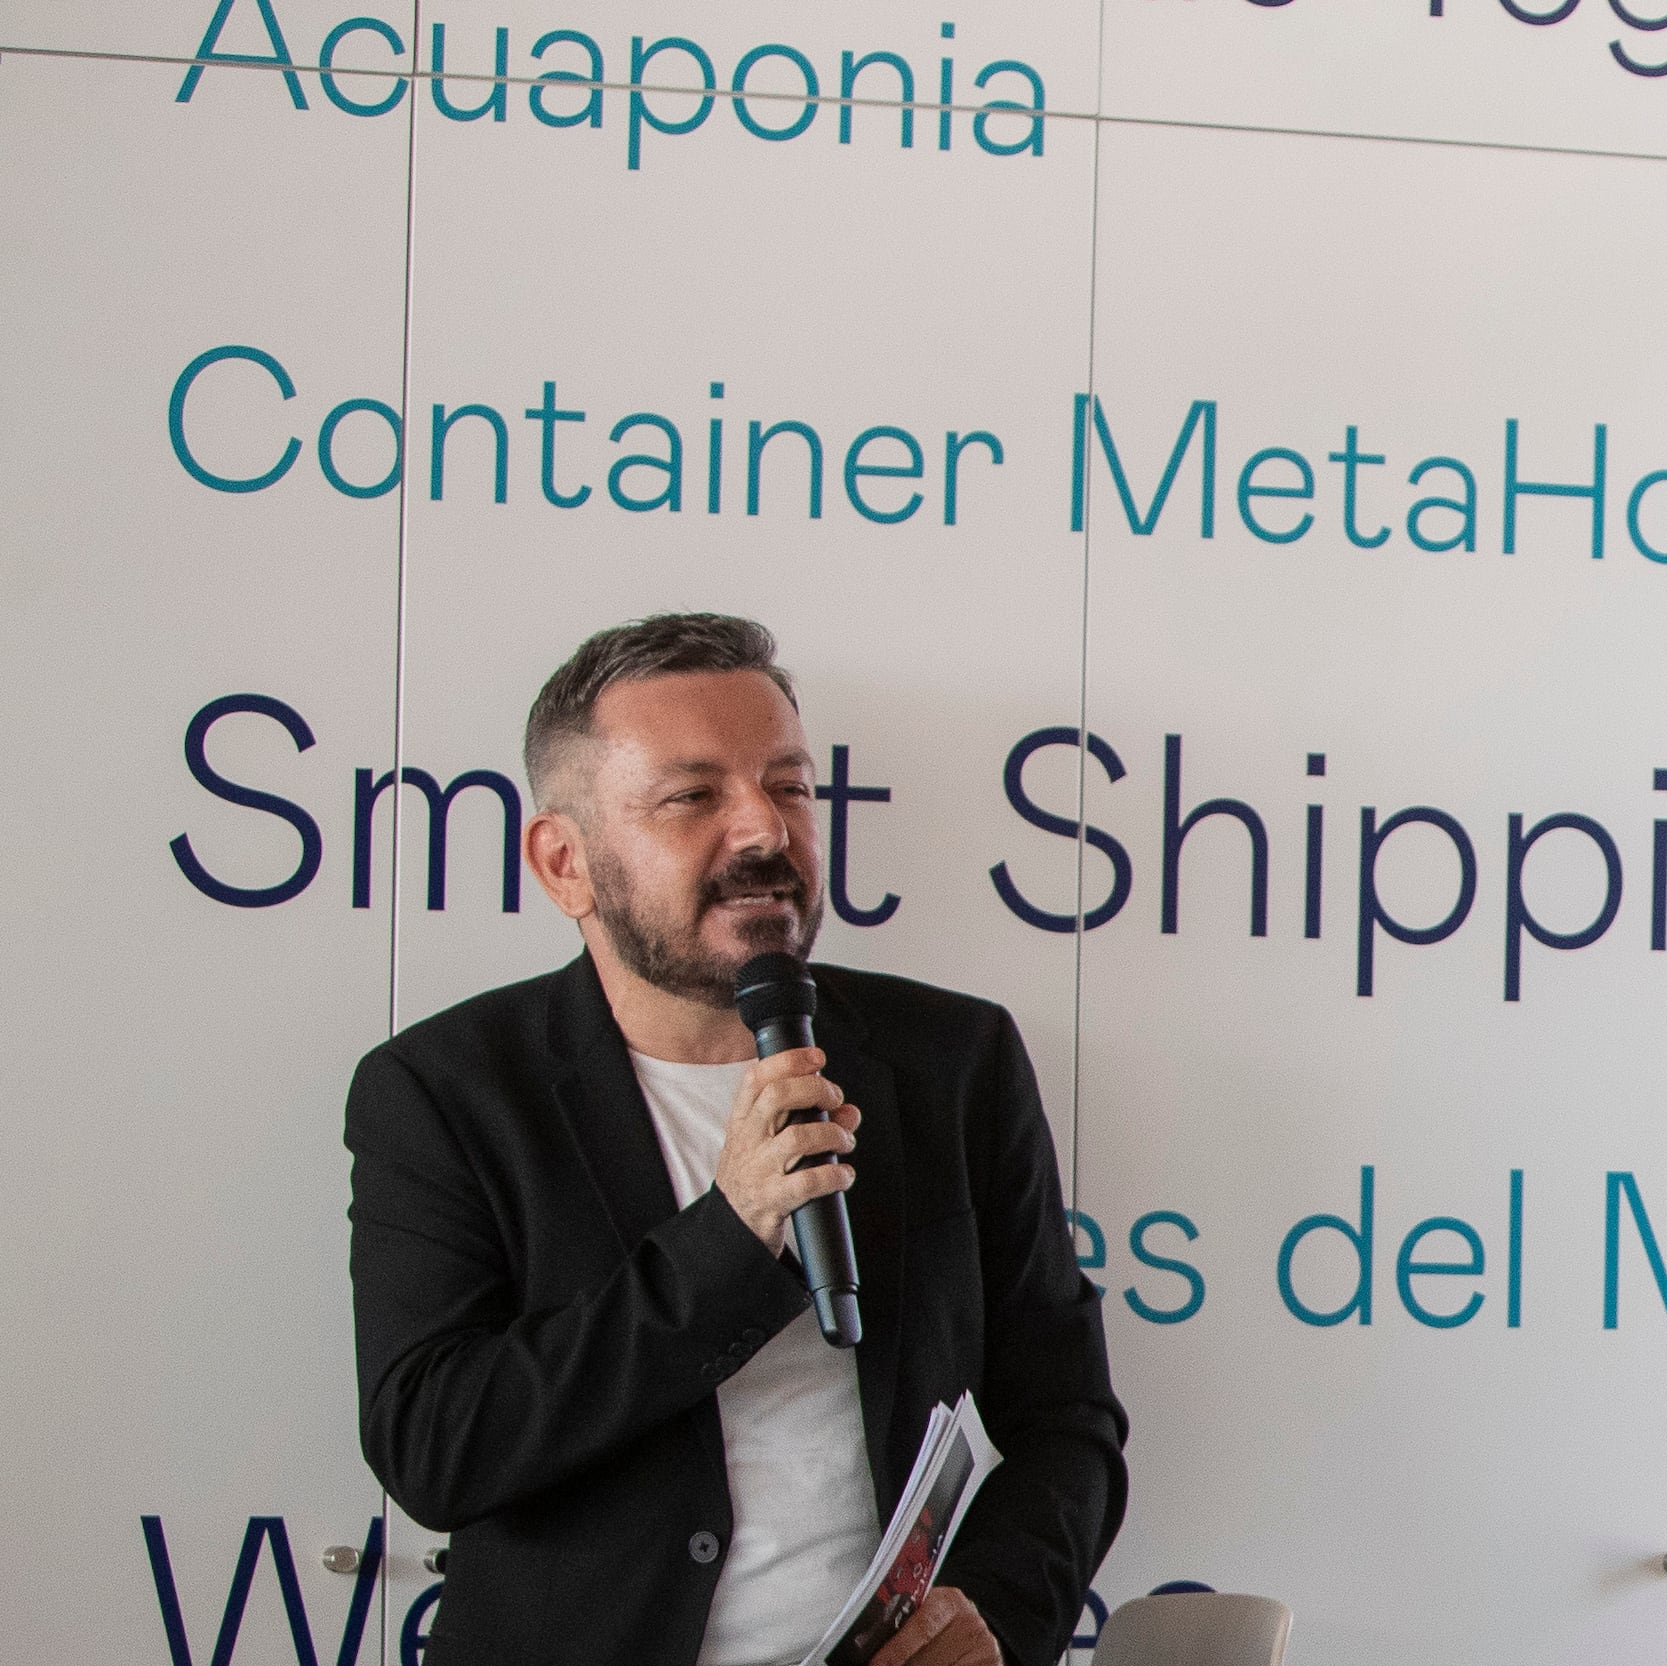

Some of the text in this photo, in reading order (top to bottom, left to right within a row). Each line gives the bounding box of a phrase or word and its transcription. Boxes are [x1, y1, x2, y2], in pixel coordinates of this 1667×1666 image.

[174, 0, 1046, 170] Acuaponia
[168, 344, 1004, 525] Container
[169, 693, 902, 927] Smt
[1276, 1166, 1523, 1330] del
